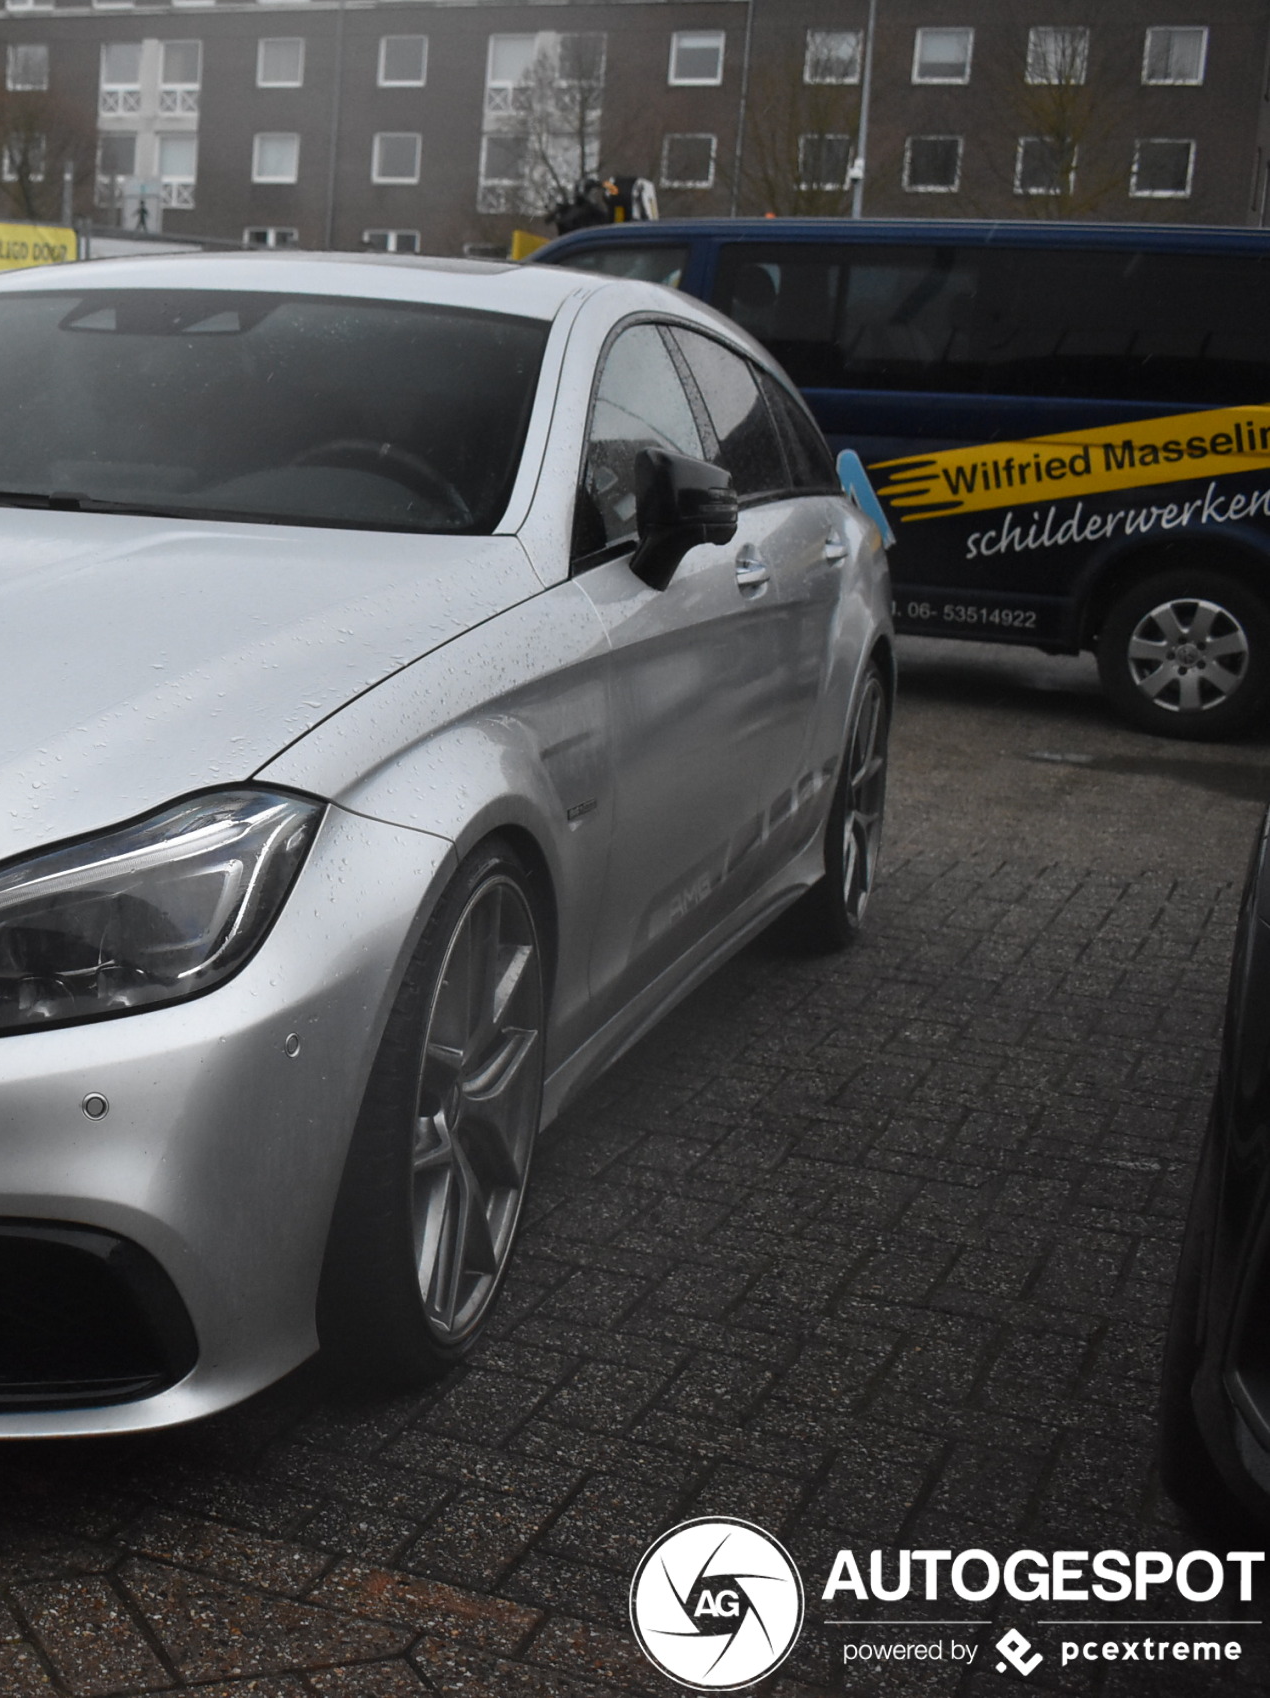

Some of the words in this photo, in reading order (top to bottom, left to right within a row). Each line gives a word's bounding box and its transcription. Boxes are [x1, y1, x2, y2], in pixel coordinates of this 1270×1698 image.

[942, 446, 1091, 496] Wilfried
[966, 481, 1270, 559] schilderwerken
[908, 602, 937, 619] 06-
[944, 604, 1036, 628] 53514922
